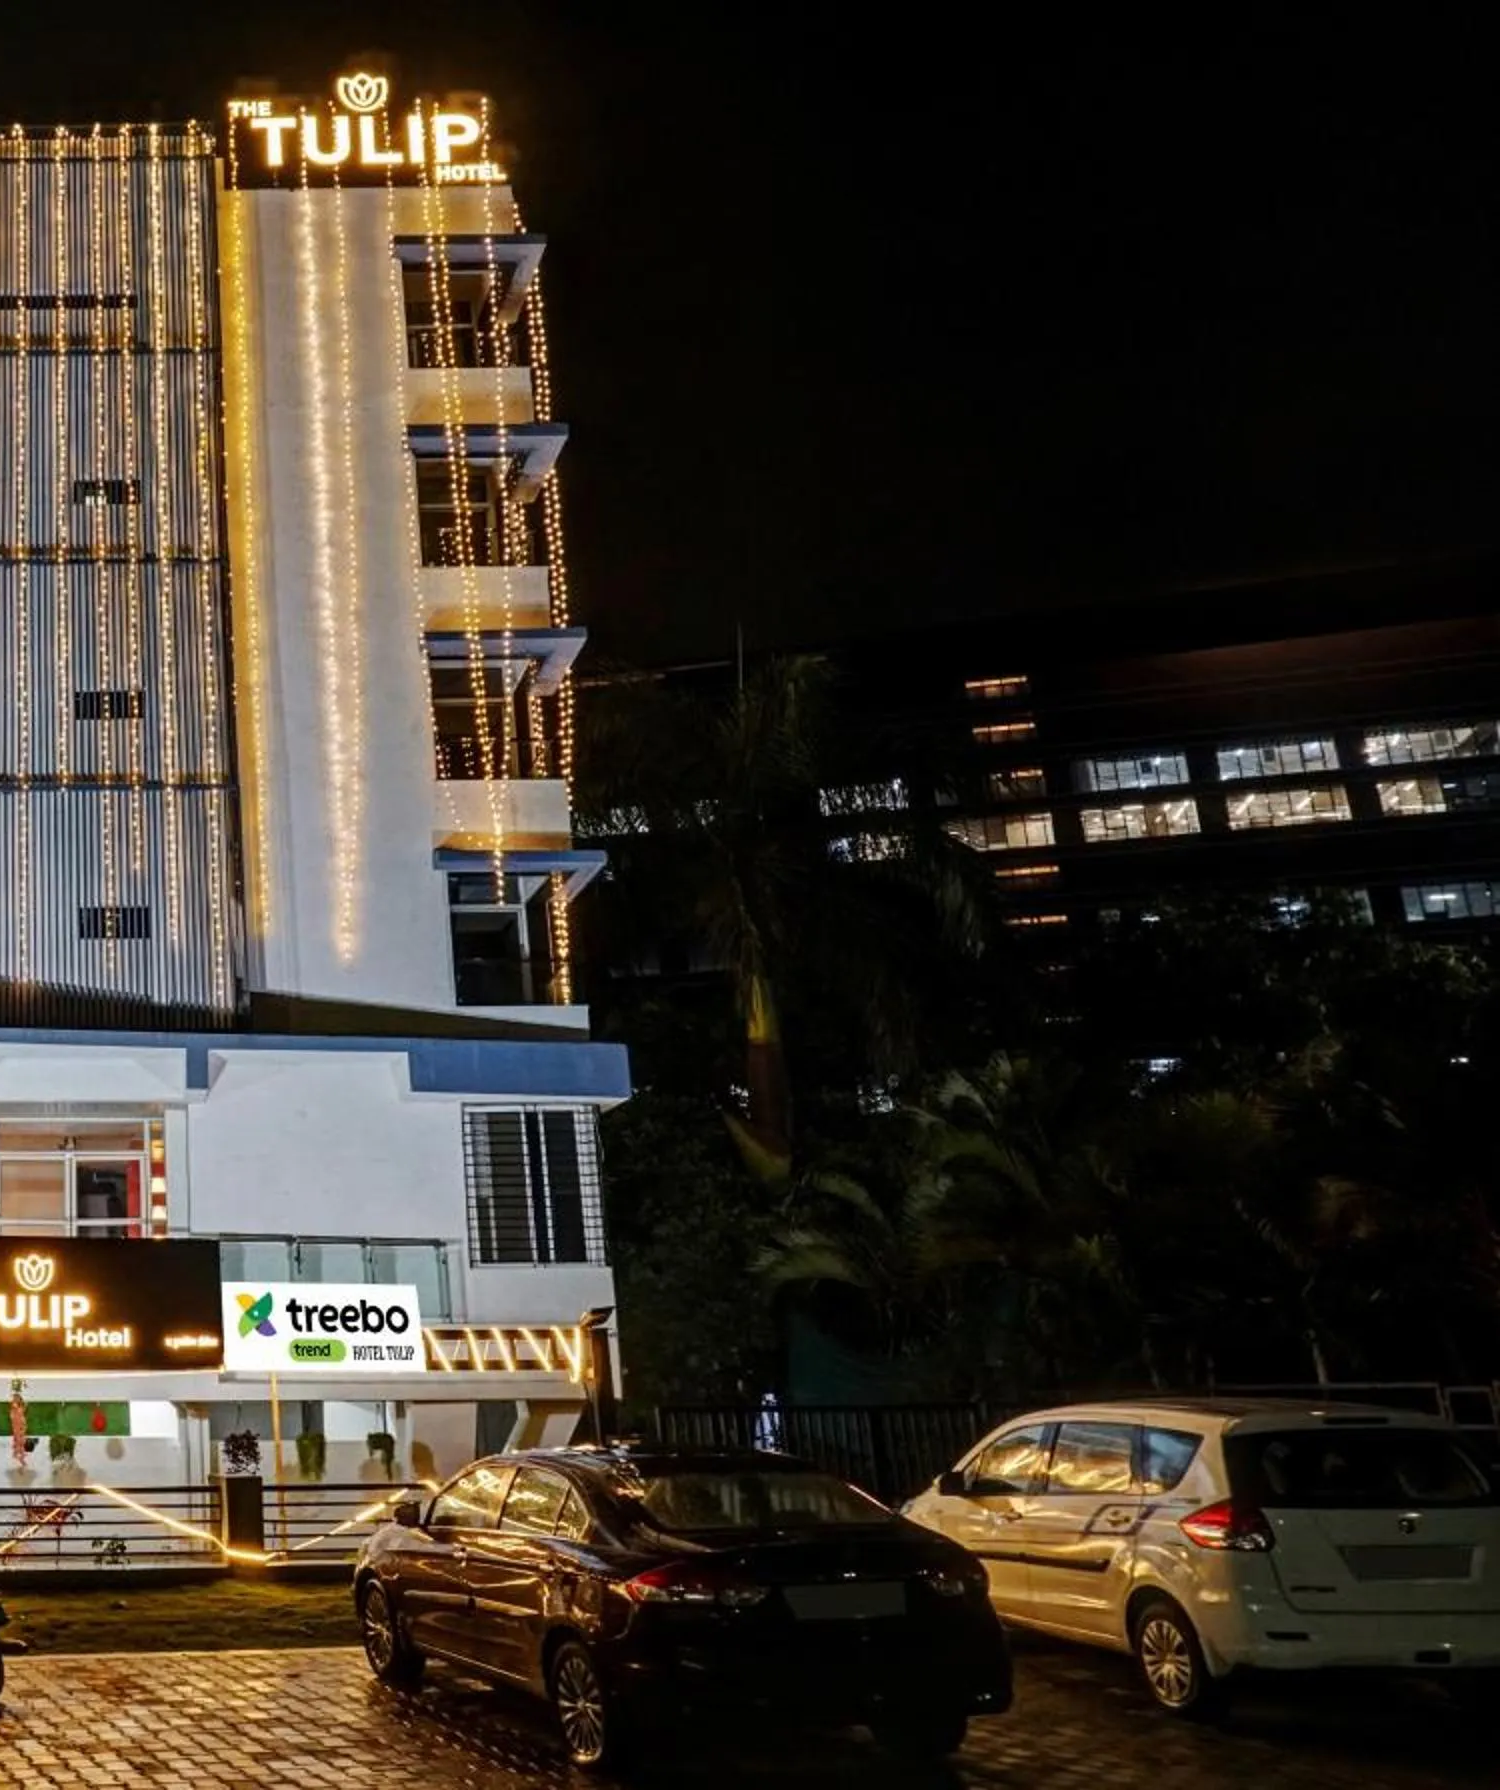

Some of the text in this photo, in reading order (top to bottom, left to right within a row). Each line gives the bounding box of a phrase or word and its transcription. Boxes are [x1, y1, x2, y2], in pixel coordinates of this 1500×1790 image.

[228, 101, 272, 117] THE
[250, 115, 481, 167] TULIP
[435, 163, 507, 182] HOTEL
[286, 1298, 409, 1334] treebo
[65, 1328, 131, 1348] Hotel
[294, 1344, 331, 1357] trend
[352, 1345, 415, 1361] HOTEL TULIP
